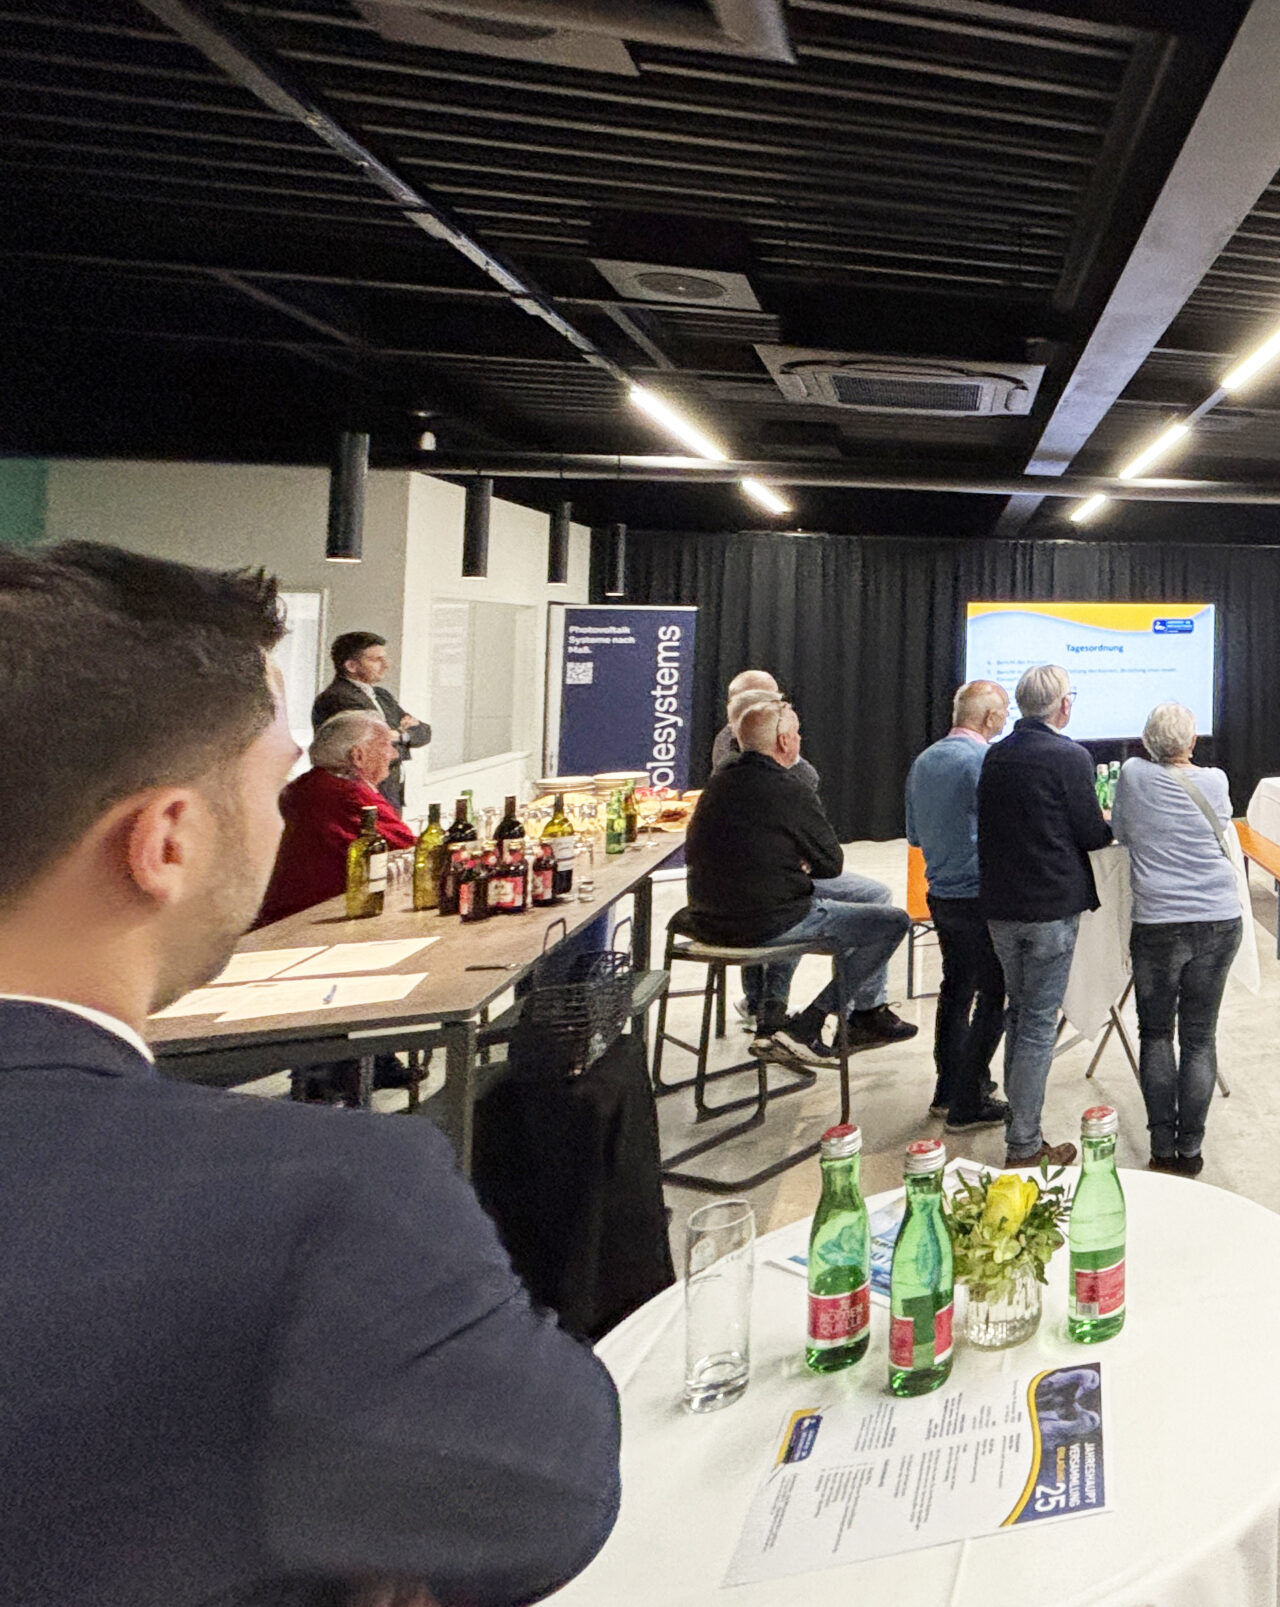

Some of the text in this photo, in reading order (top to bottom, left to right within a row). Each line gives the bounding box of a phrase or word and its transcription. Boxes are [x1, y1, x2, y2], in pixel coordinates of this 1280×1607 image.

[612, 636, 636, 644] nach
[1066, 644, 1124, 653] Tagesordnung
[646, 625, 684, 792] olesystems
[1068, 1443, 1081, 1508] VERSAMMLUNG
[1084, 1442, 1097, 1504] JAHRESHAUPT
[1034, 1483, 1067, 1513] 25
